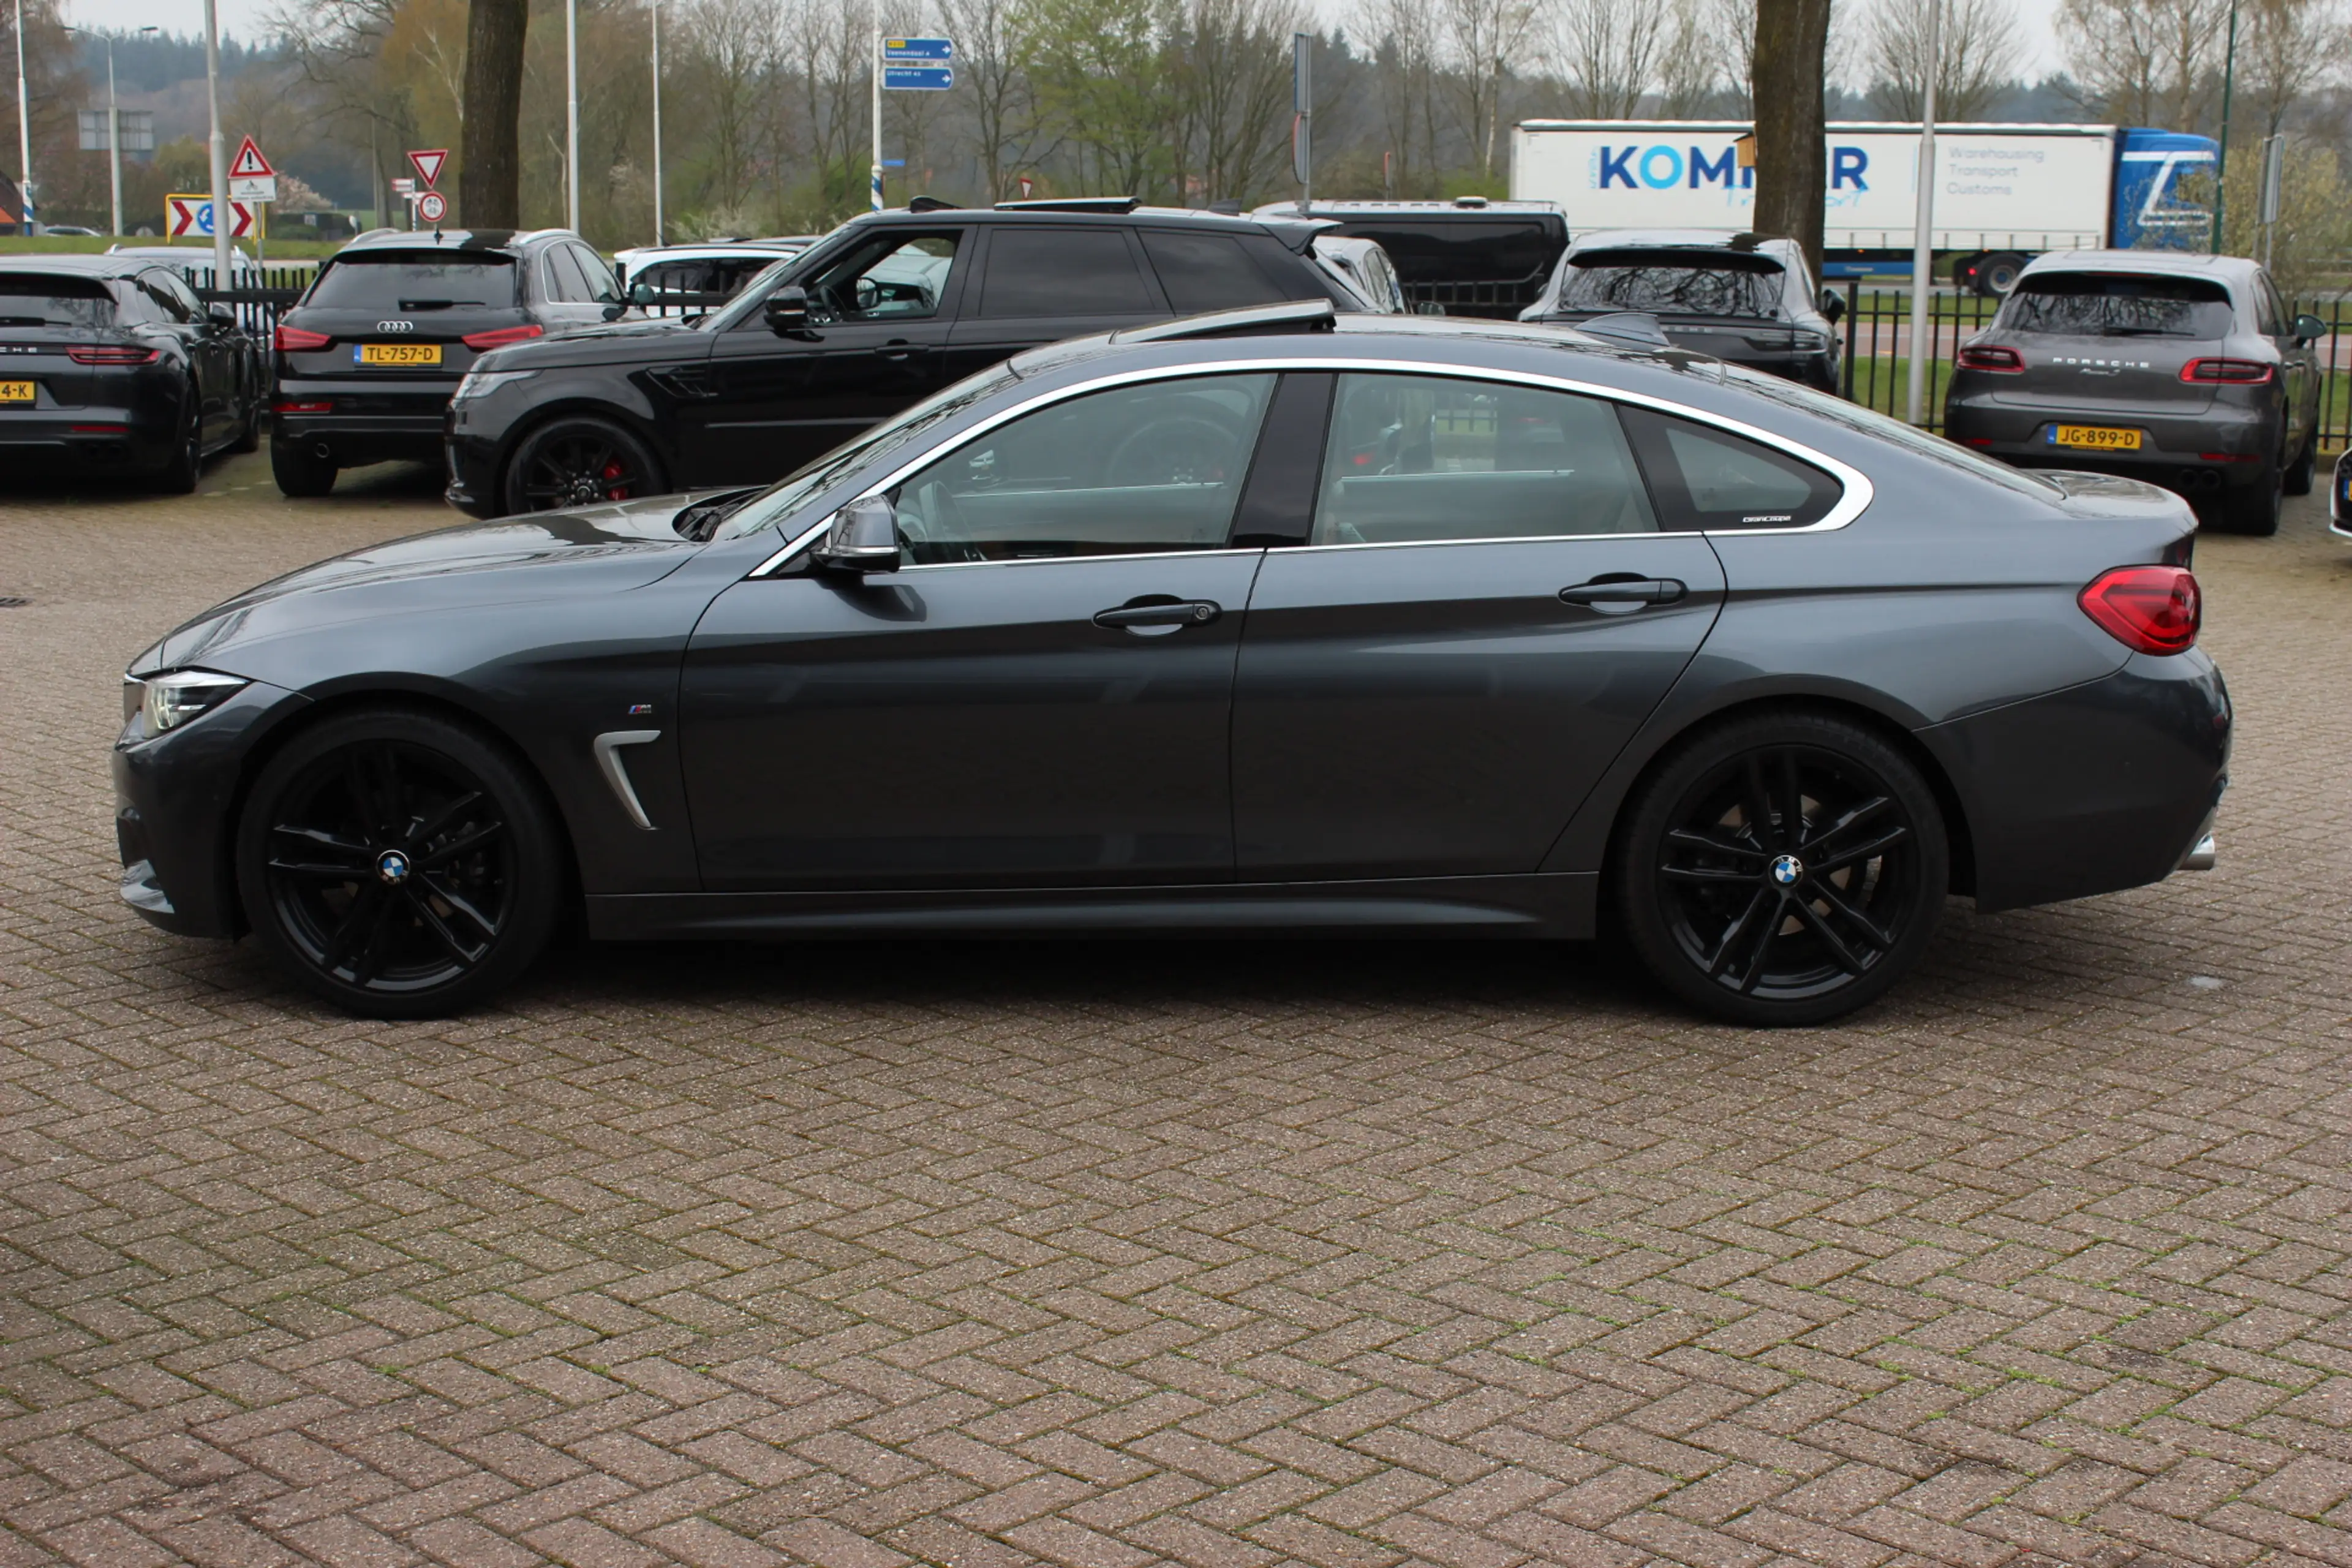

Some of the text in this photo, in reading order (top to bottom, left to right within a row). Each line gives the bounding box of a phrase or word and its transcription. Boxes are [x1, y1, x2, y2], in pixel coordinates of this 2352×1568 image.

[1948, 146, 2045, 164] Warehousing
[1599, 145, 1869, 189] KOMR
[1948, 164, 2018, 179] Transport
[1946, 181, 2013, 195] Customs
[368, 347, 433, 360] TL-757-D
[2052, 357, 2149, 368] PORSCHE
[2061, 429, 2135, 446] JG-899-D
